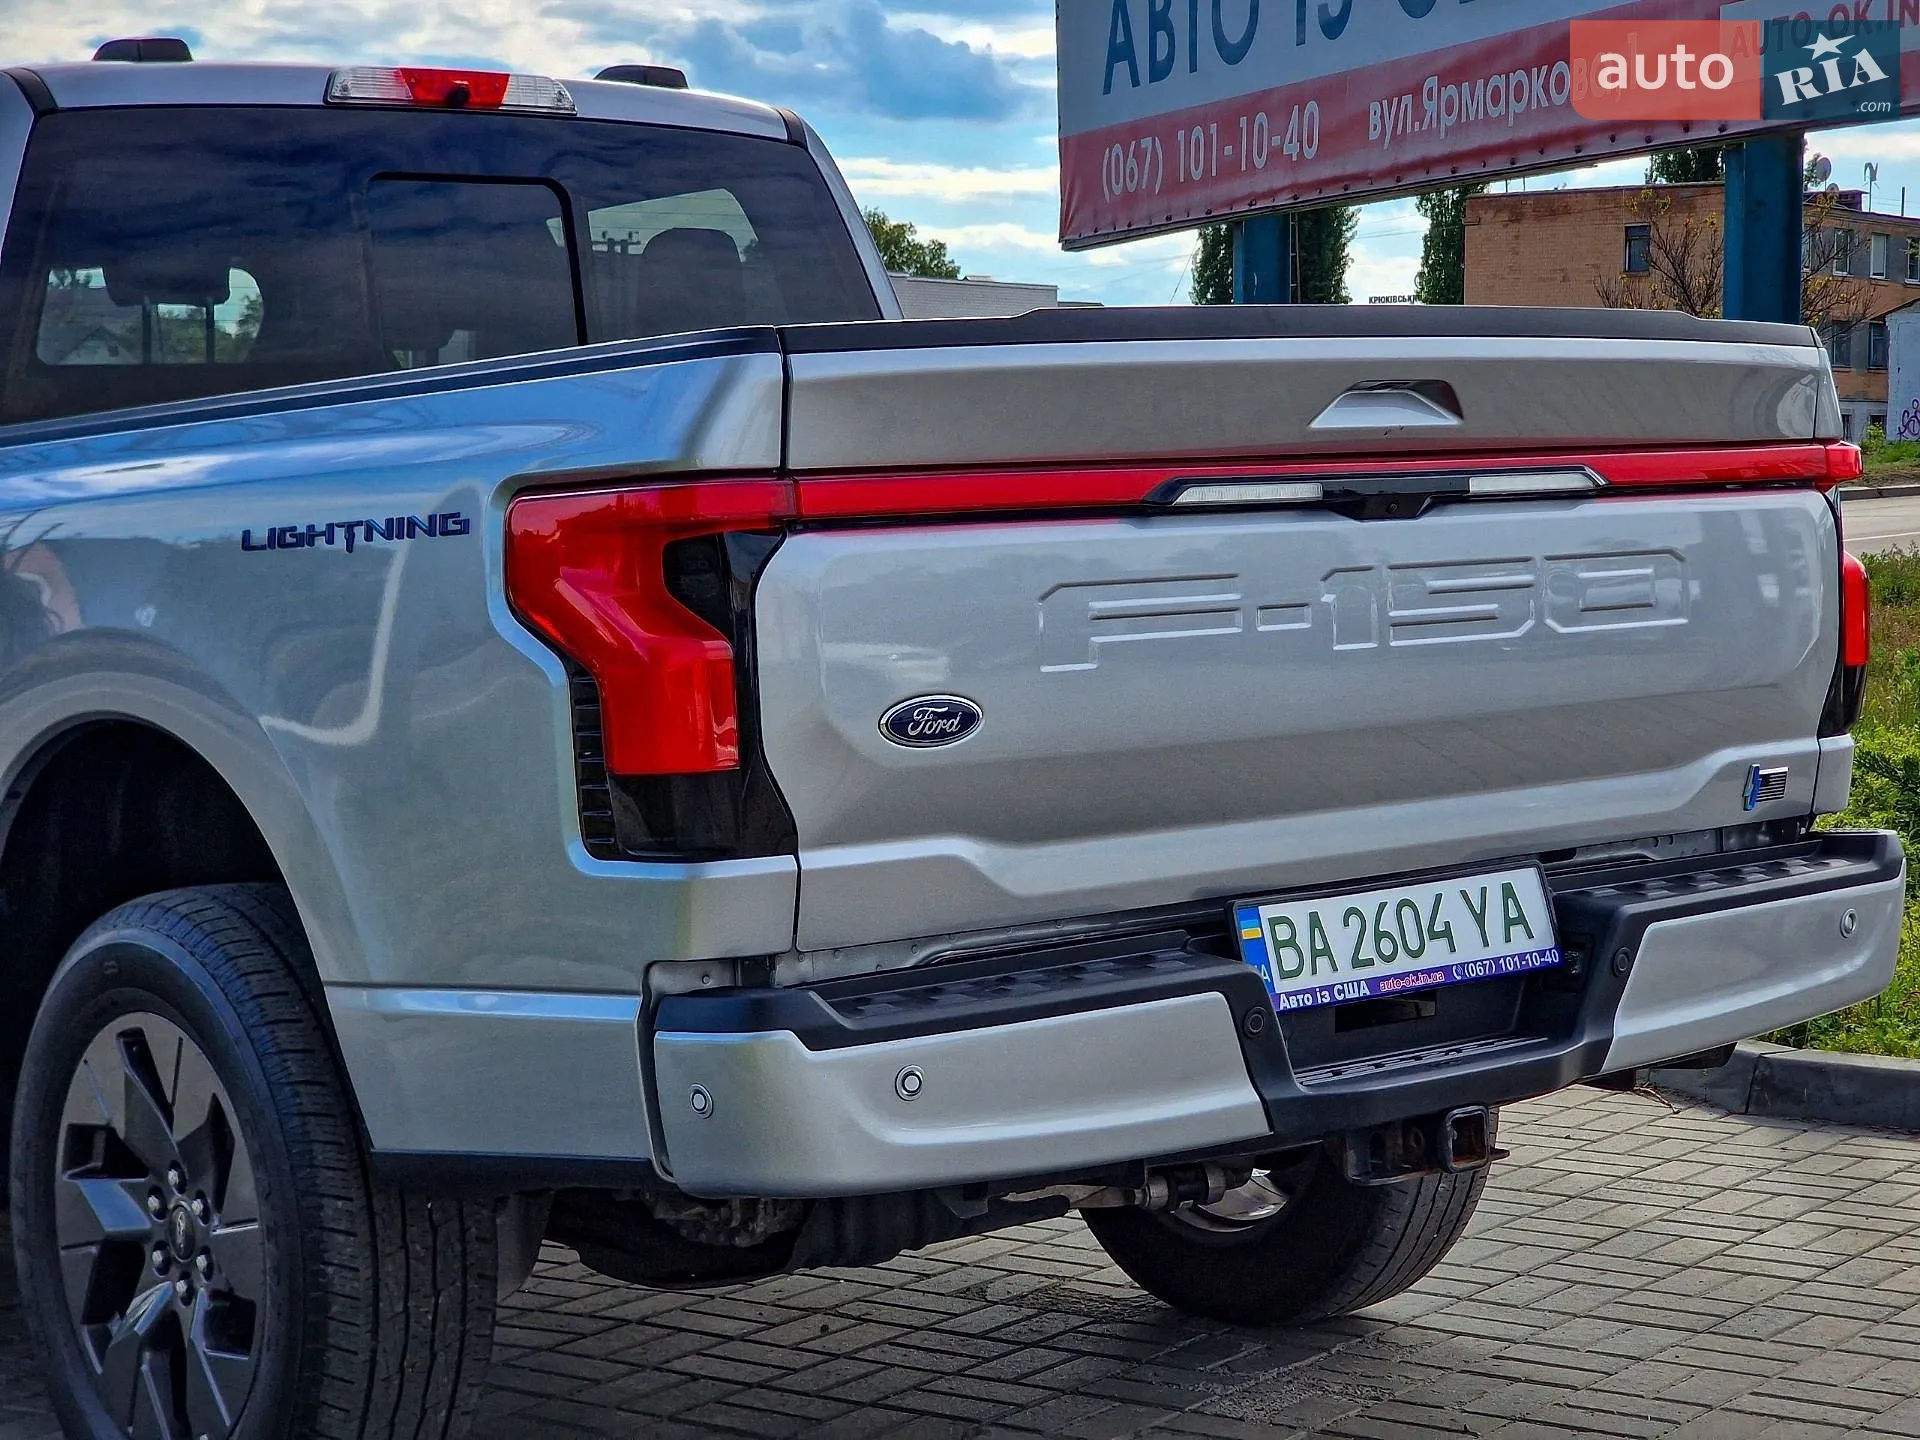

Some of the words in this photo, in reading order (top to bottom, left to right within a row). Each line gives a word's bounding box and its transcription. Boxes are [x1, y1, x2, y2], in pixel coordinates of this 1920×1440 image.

[1102, 136, 1163, 201] (067)
[1176, 100, 1320, 183] 101-10-40
[241, 511, 470, 553] LIGHTNING
[1038, 548, 1691, 673] F-150
[907, 706, 963, 736] Ford
[1279, 993, 1313, 1010] Авто
[1316, 988, 1331, 1003] із
[1333, 981, 1370, 1000] США
[1379, 971, 1445, 991] auto-ok.in.ua
[1464, 960, 1496, 978] (067)
[1499, 949, 1560, 971] 101-10-40
